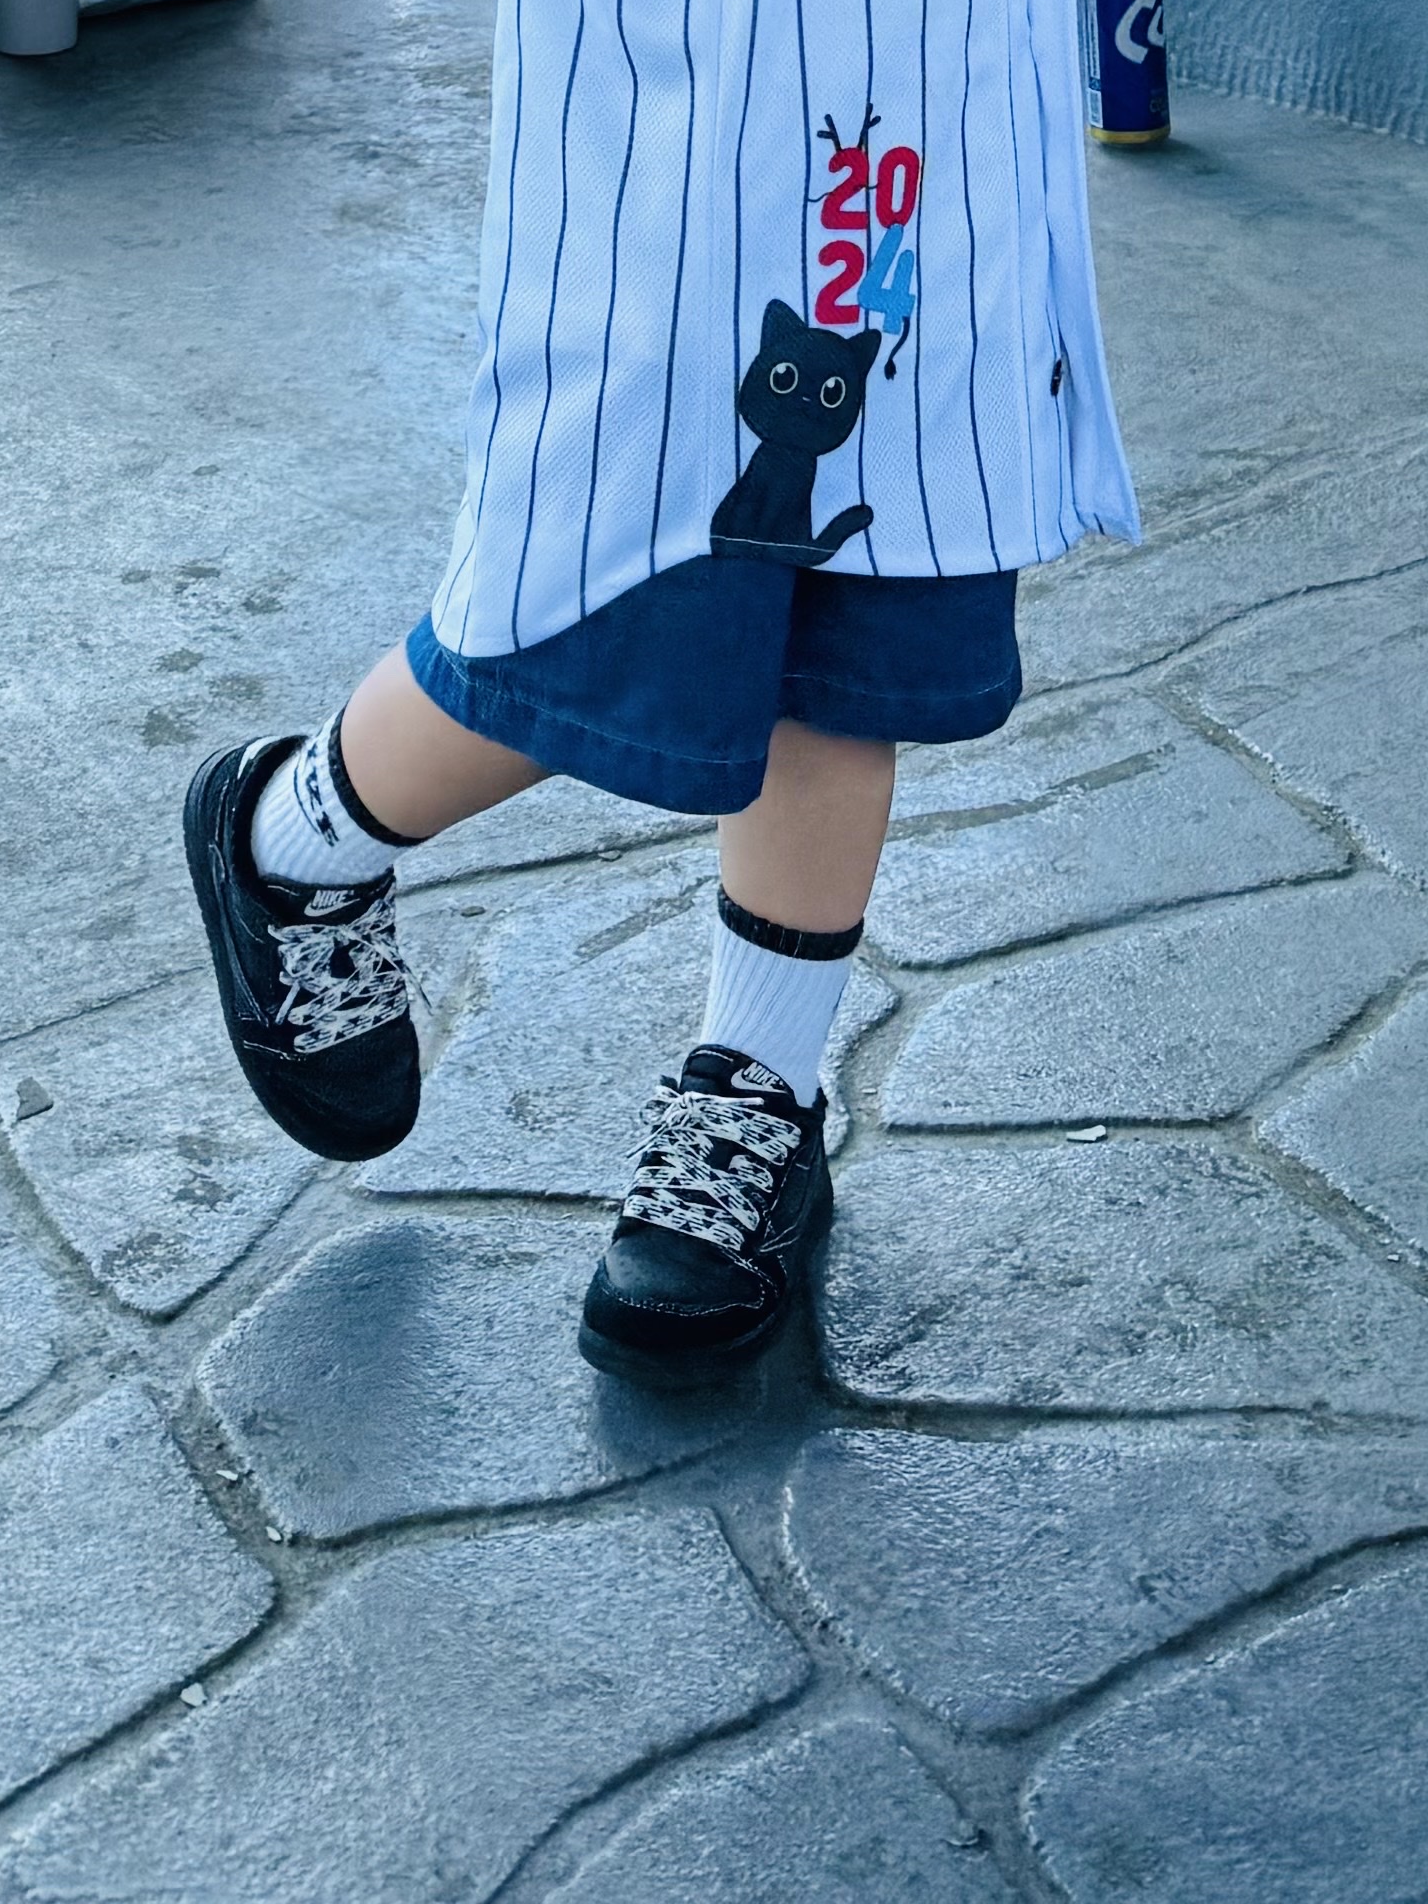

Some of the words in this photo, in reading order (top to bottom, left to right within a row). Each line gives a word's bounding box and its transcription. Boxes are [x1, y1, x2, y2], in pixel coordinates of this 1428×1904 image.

[819, 144, 922, 231] 20
[813, 222, 917, 336] 24
[311, 889, 349, 909] NIKE
[743, 1061, 781, 1087] NIKE
